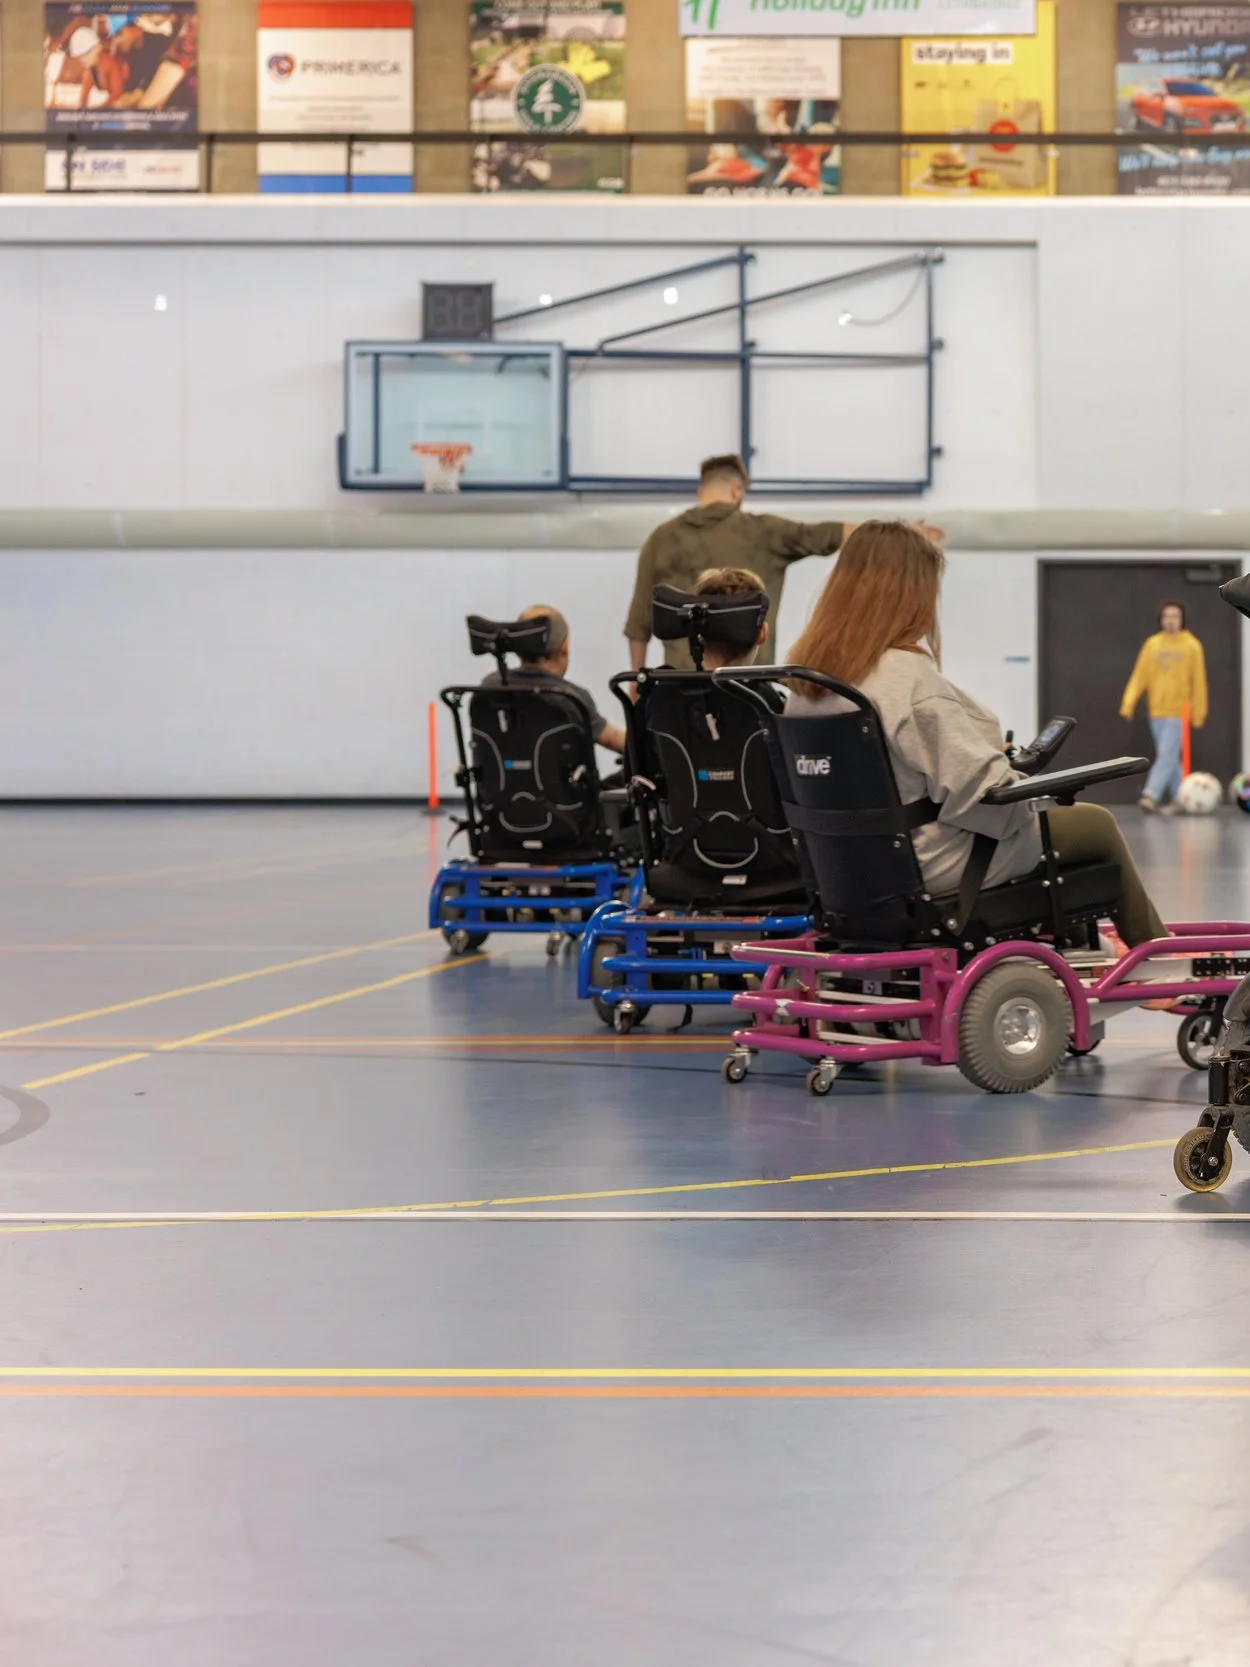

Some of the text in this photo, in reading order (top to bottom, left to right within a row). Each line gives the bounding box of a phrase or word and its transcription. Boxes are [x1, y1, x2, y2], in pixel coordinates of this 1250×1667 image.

[916, 44, 1010, 65] staying in
[301, 59, 403, 75] PRIMERICA
[796, 755, 831, 775] drive
